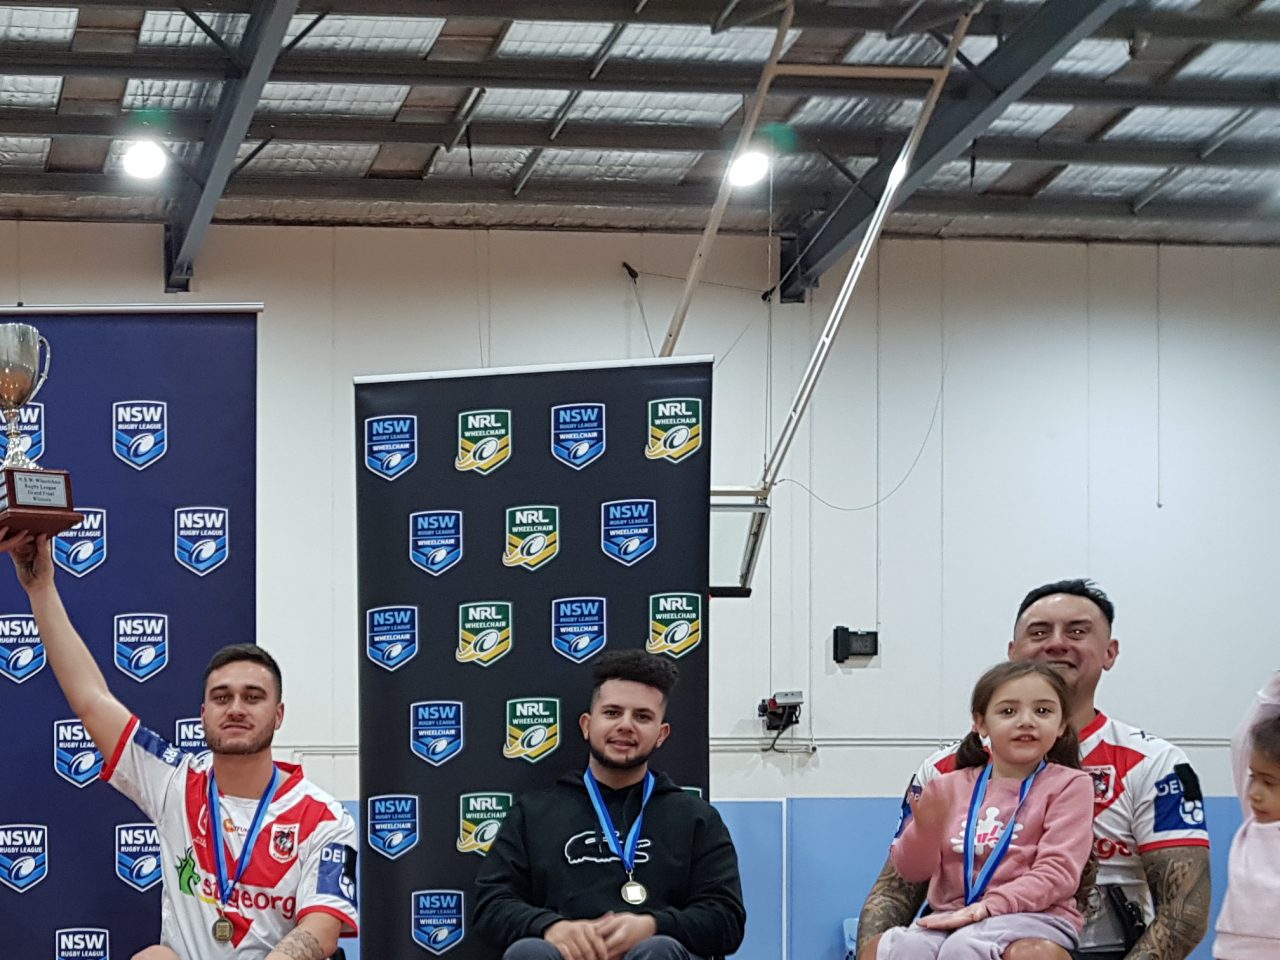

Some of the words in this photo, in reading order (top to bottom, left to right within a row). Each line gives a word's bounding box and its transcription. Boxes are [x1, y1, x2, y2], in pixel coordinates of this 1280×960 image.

[118, 407, 162, 421] NSW
[559, 408, 598, 422] NSW
[658, 402, 692, 416] NRL
[373, 420, 410, 433] NSW
[468, 414, 501, 428] NRL
[655, 416, 696, 425] WHEELCHAIR
[464, 428, 505, 437] WHEELCHAIR
[559, 430, 598, 438] WHEELCHAIR
[516, 510, 549, 524] NRL
[609, 504, 649, 518] NSW
[180, 513, 223, 528] NSW
[417, 516, 455, 528] NSW
[512, 524, 553, 532] WHEELCHAIR
[609, 527, 649, 535] WHEELCHAIR
[560, 602, 599, 615] NSW
[660, 597, 692, 611] NRL
[374, 611, 411, 624] NSW
[468, 606, 502, 620] NRL
[656, 611, 696, 619] WHEELCHAIR
[119, 619, 163, 634] NSW
[465, 620, 506, 628] WHEELCHAIR
[560, 624, 599, 632] WHEELCHAIR
[374, 634, 411, 642] WHEELCHAIR
[418, 706, 455, 719] NSW
[516, 703, 549, 716] NRL
[512, 716, 554, 724] WHEELCHAIR
[375, 800, 411, 812] NSW
[470, 797, 502, 810] NRL
[0, 831, 43, 845] NSW
[420, 895, 457, 908] NSW
[61, 934, 104, 949] NSW
